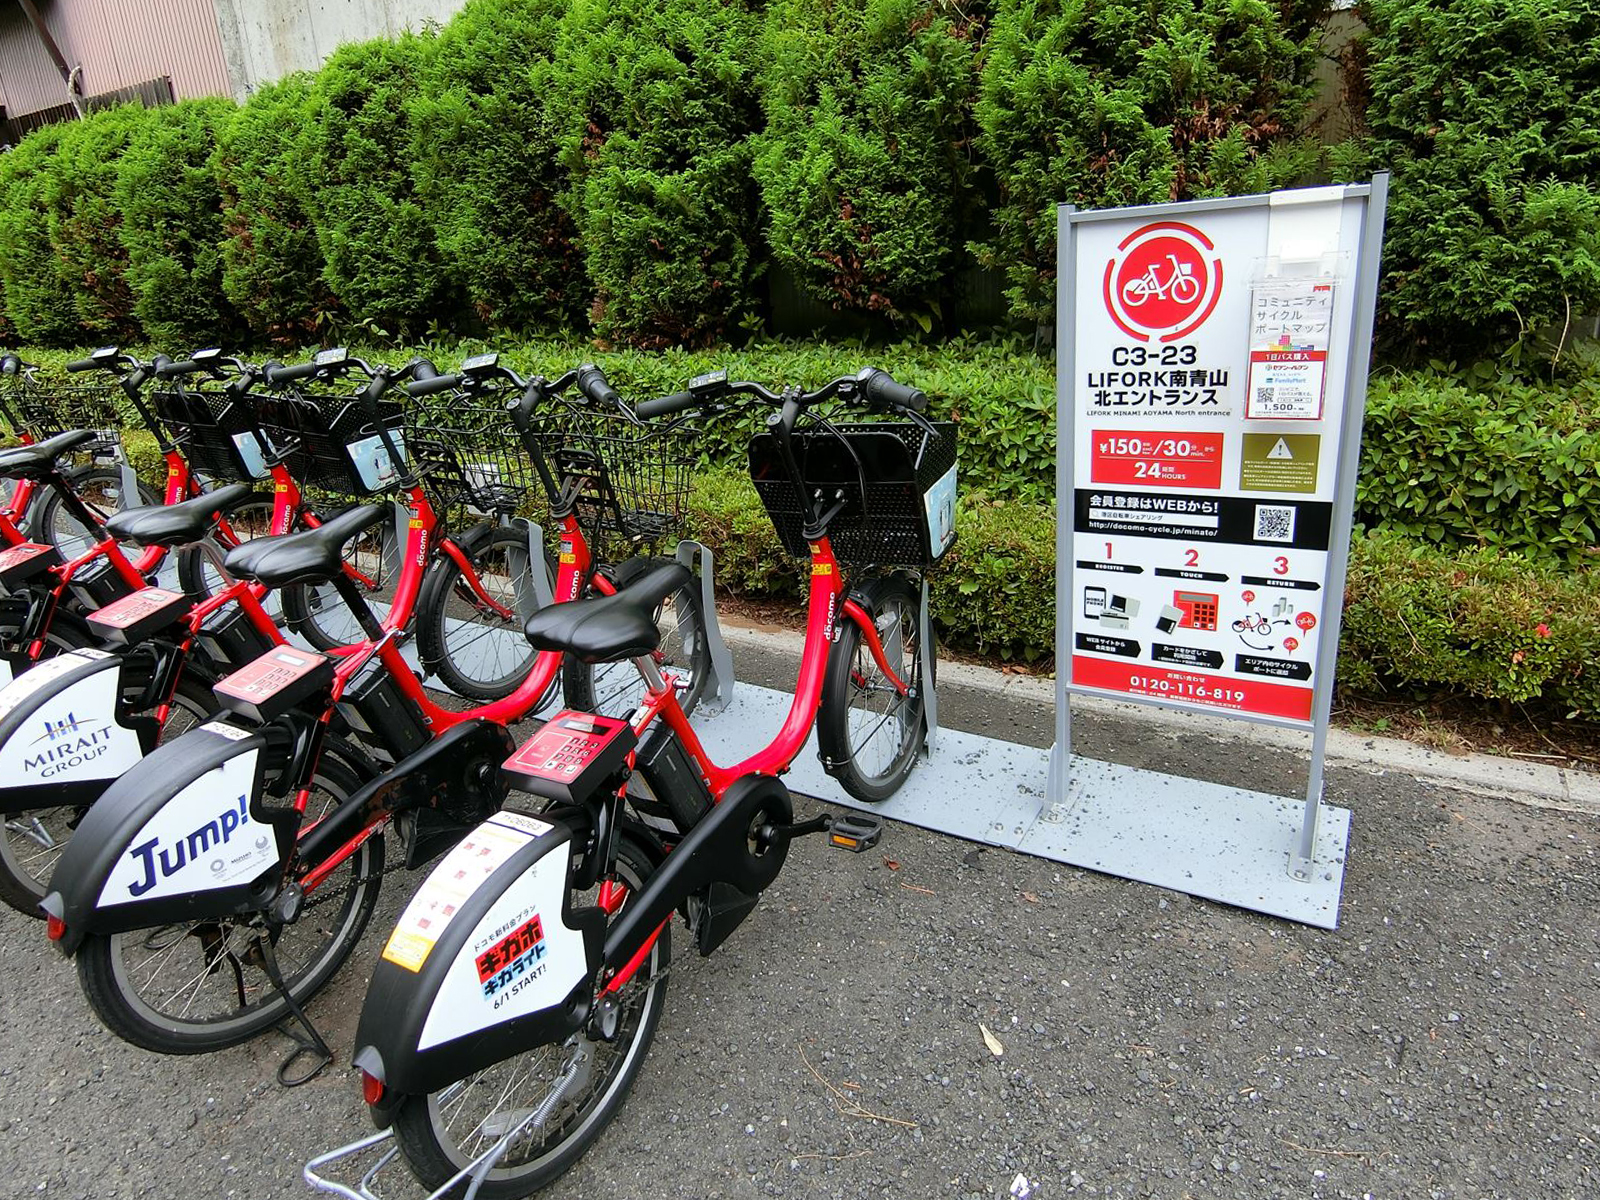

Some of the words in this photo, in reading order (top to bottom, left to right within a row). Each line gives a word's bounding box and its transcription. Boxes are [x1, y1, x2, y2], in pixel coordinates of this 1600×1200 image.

[1258, 296, 1327, 307] コミュニティ
[1257, 310, 1303, 320] サイクル
[1112, 345, 1197, 366] C3-23
[1088, 369, 1228, 388] LIFORK南青山
[1094, 389, 1218, 407] 北エントランス
[1134, 462, 1162, 478] 24
[1088, 521, 1218, 537] http://docomo-cycle.jp/minato/
[416, 529, 427, 567] docomo
[1105, 542, 1112, 559] 1
[1184, 548, 1199, 567] 2
[1273, 556, 1289, 575] 3
[1095, 563, 1125, 571] REGISTER
[1180, 571, 1203, 579] TOUCH
[569, 570, 580, 600] como
[1266, 579, 1295, 588] RETURN
[823, 591, 836, 641] docomo
[1163, 645, 1208, 657] カードをかざして
[1244, 658, 1299, 670] エリア内のサイクル
[1166, 672, 1206, 683] お問い合わせ
[1130, 675, 1245, 702] 0120-116-819
[24, 725, 113, 772] MIRAIT
[41, 745, 108, 778] GROUP
[127, 794, 249, 897] Jump!
[474, 904, 536, 952] ドコモ新料金プラン
[480, 920, 539, 976] ギガホ
[484, 944, 546, 996] ギガライト
[493, 992, 511, 1010] 6/1
[511, 963, 547, 995] START!
